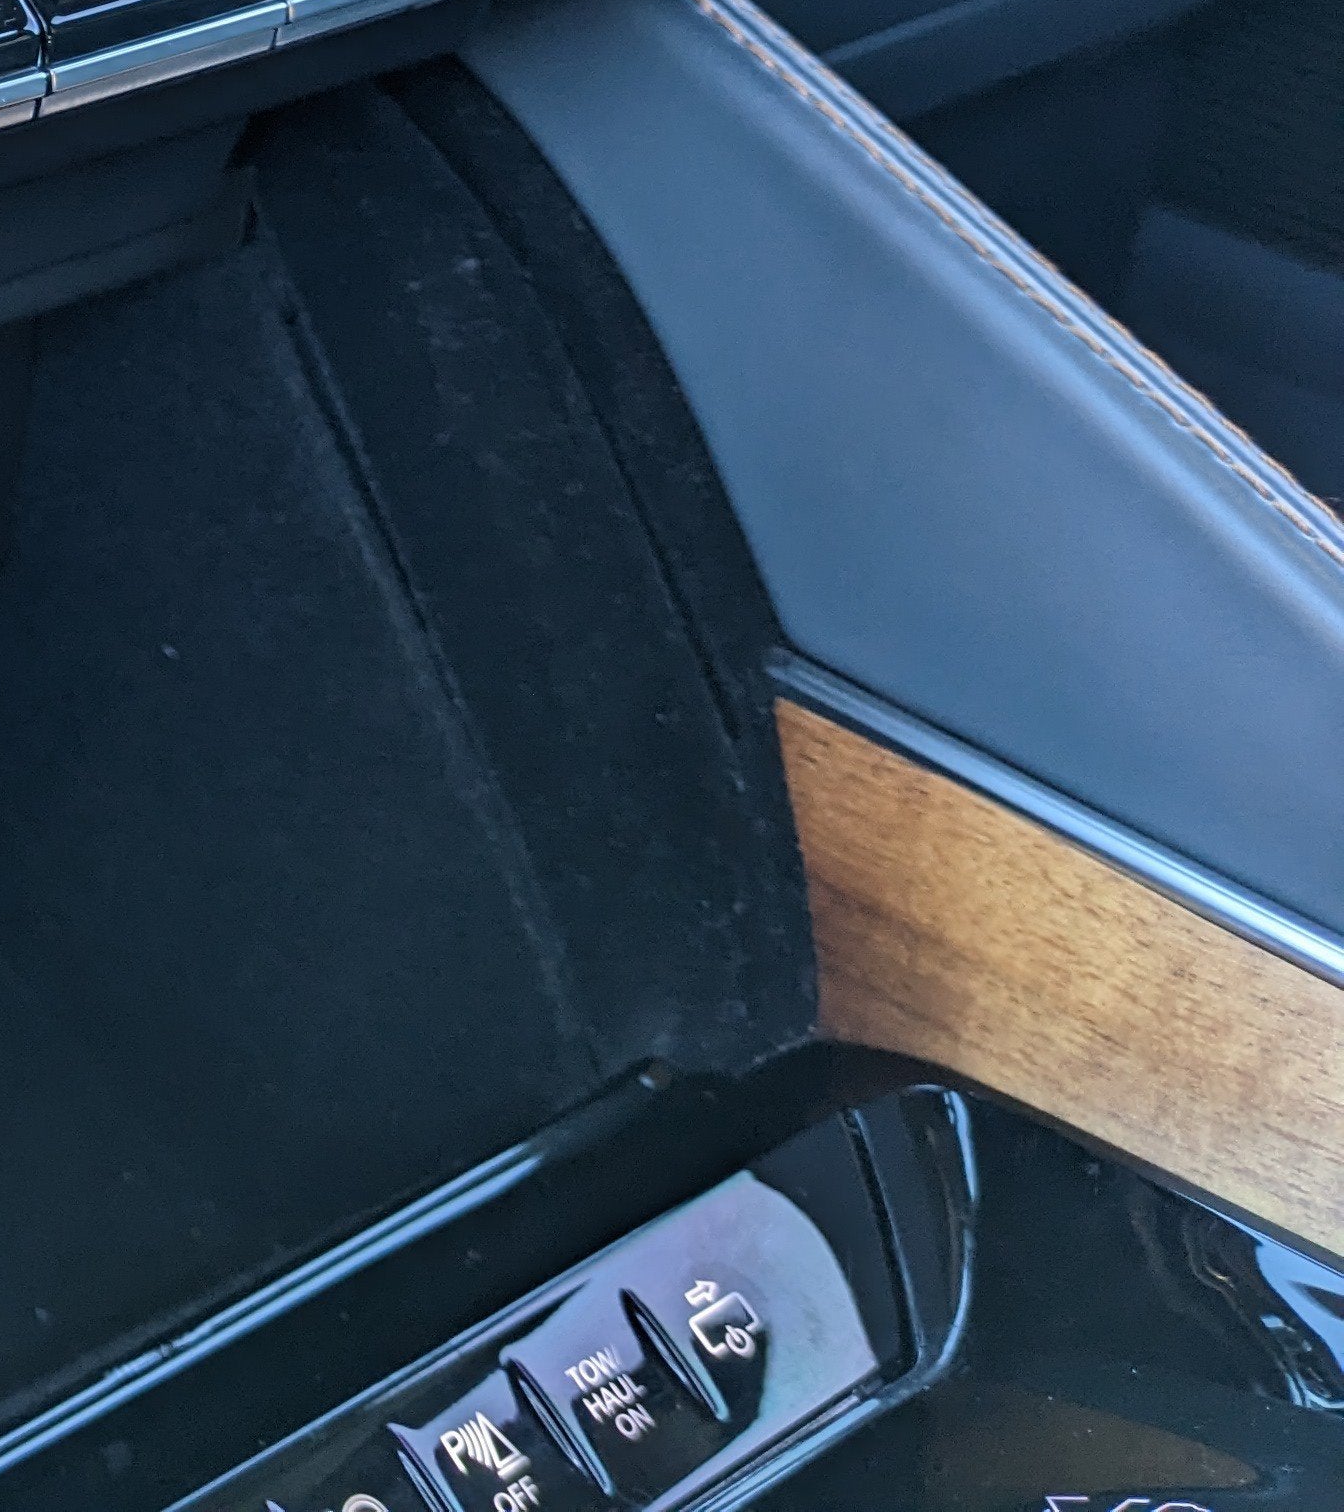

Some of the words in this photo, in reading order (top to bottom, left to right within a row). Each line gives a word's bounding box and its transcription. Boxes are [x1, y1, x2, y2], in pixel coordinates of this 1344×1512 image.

[582, 1373, 649, 1424] HAUL
[615, 1402, 657, 1442] ON
[492, 1474, 542, 1512] OFF
